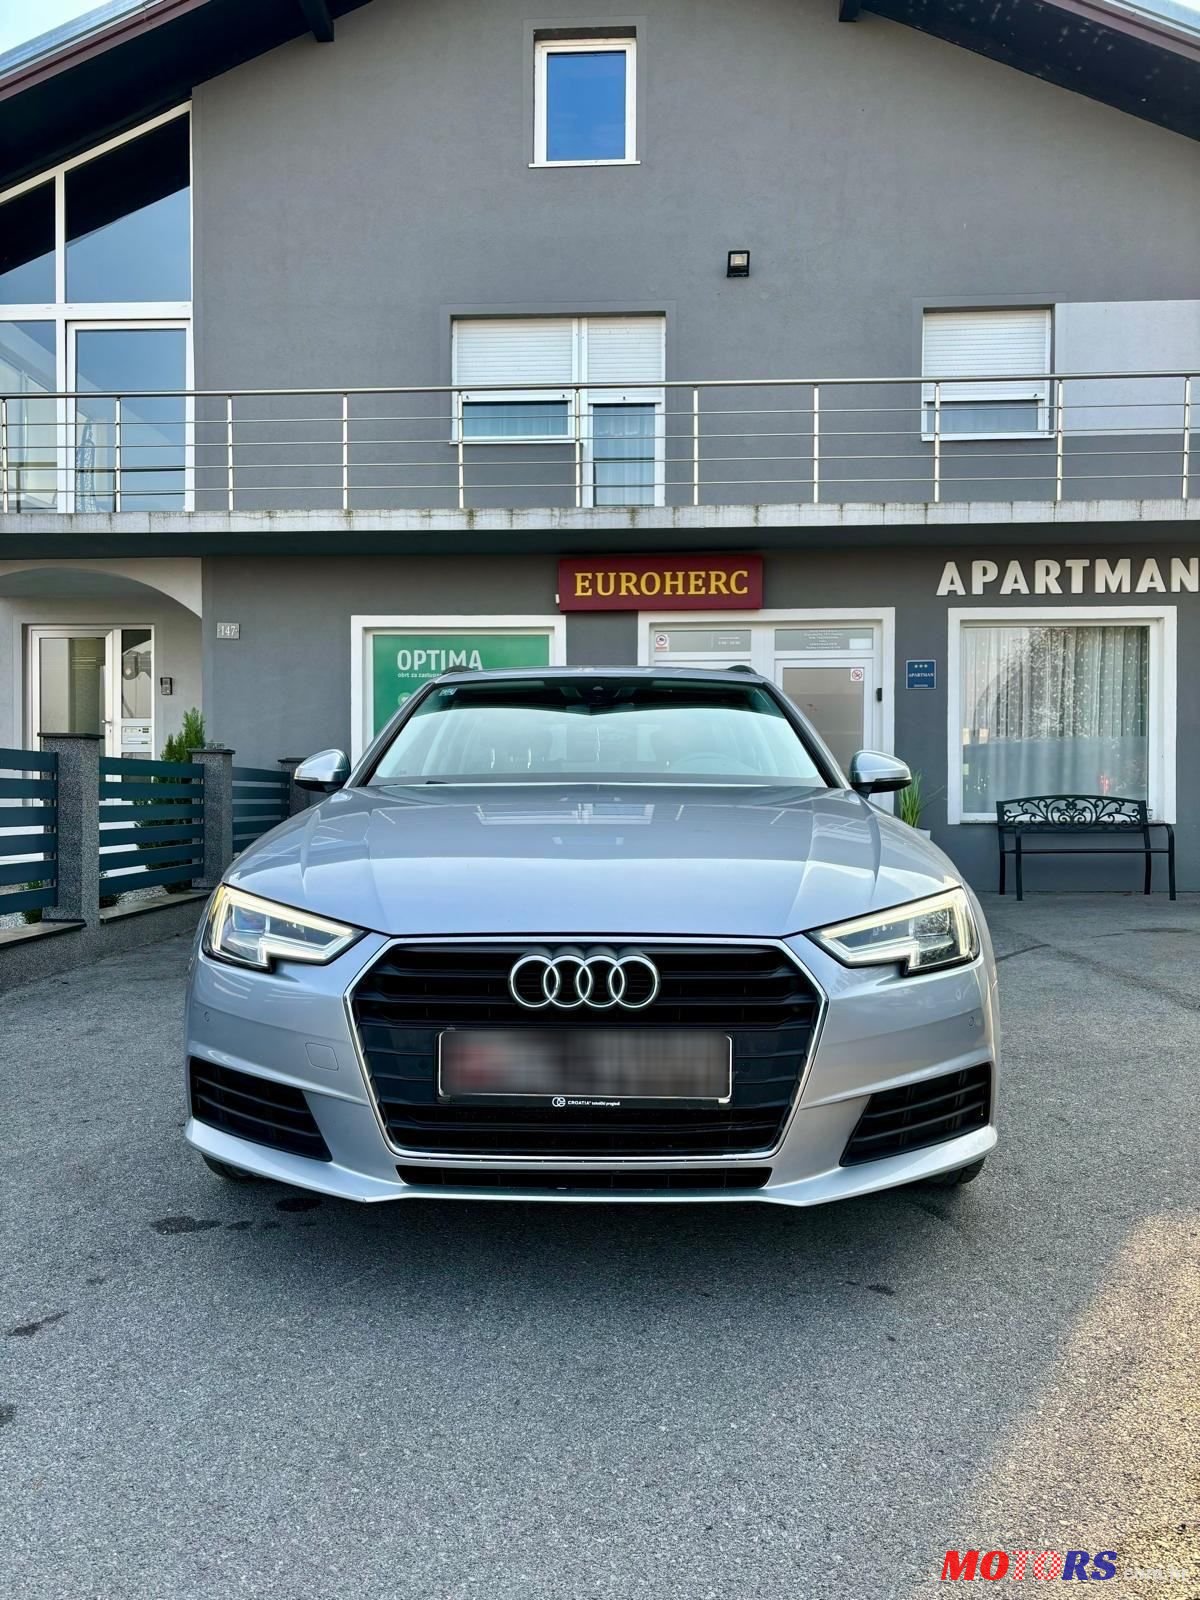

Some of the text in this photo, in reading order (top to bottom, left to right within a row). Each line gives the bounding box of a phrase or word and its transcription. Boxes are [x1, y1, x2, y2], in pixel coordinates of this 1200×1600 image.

[574, 570, 748, 596] EUROHERC
[936, 558, 1199, 596] APARTMAN
[397, 649, 483, 671] OPTIMA
